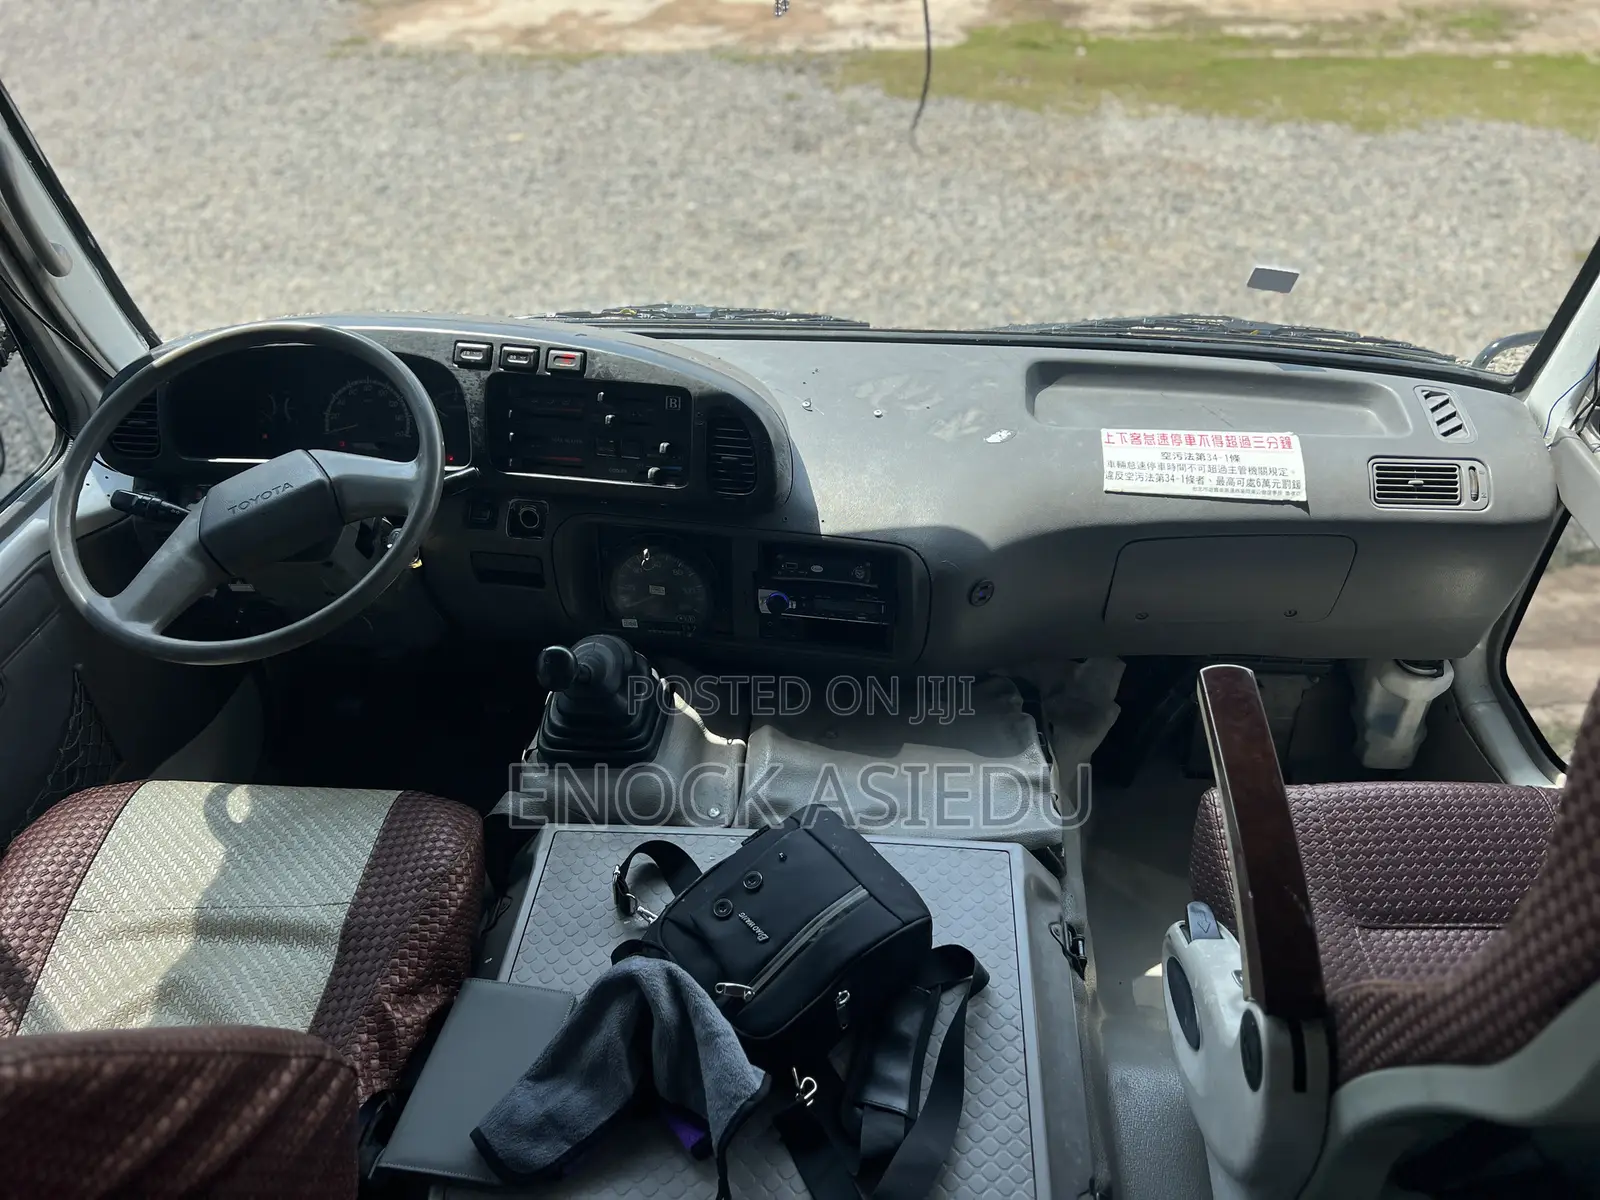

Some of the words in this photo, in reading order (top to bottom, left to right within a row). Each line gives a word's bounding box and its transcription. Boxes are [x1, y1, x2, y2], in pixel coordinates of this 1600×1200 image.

[1104, 431, 1293, 449] 上下客怠速停車不得超過三分鐘
[227, 481, 294, 515] TOYOTA
